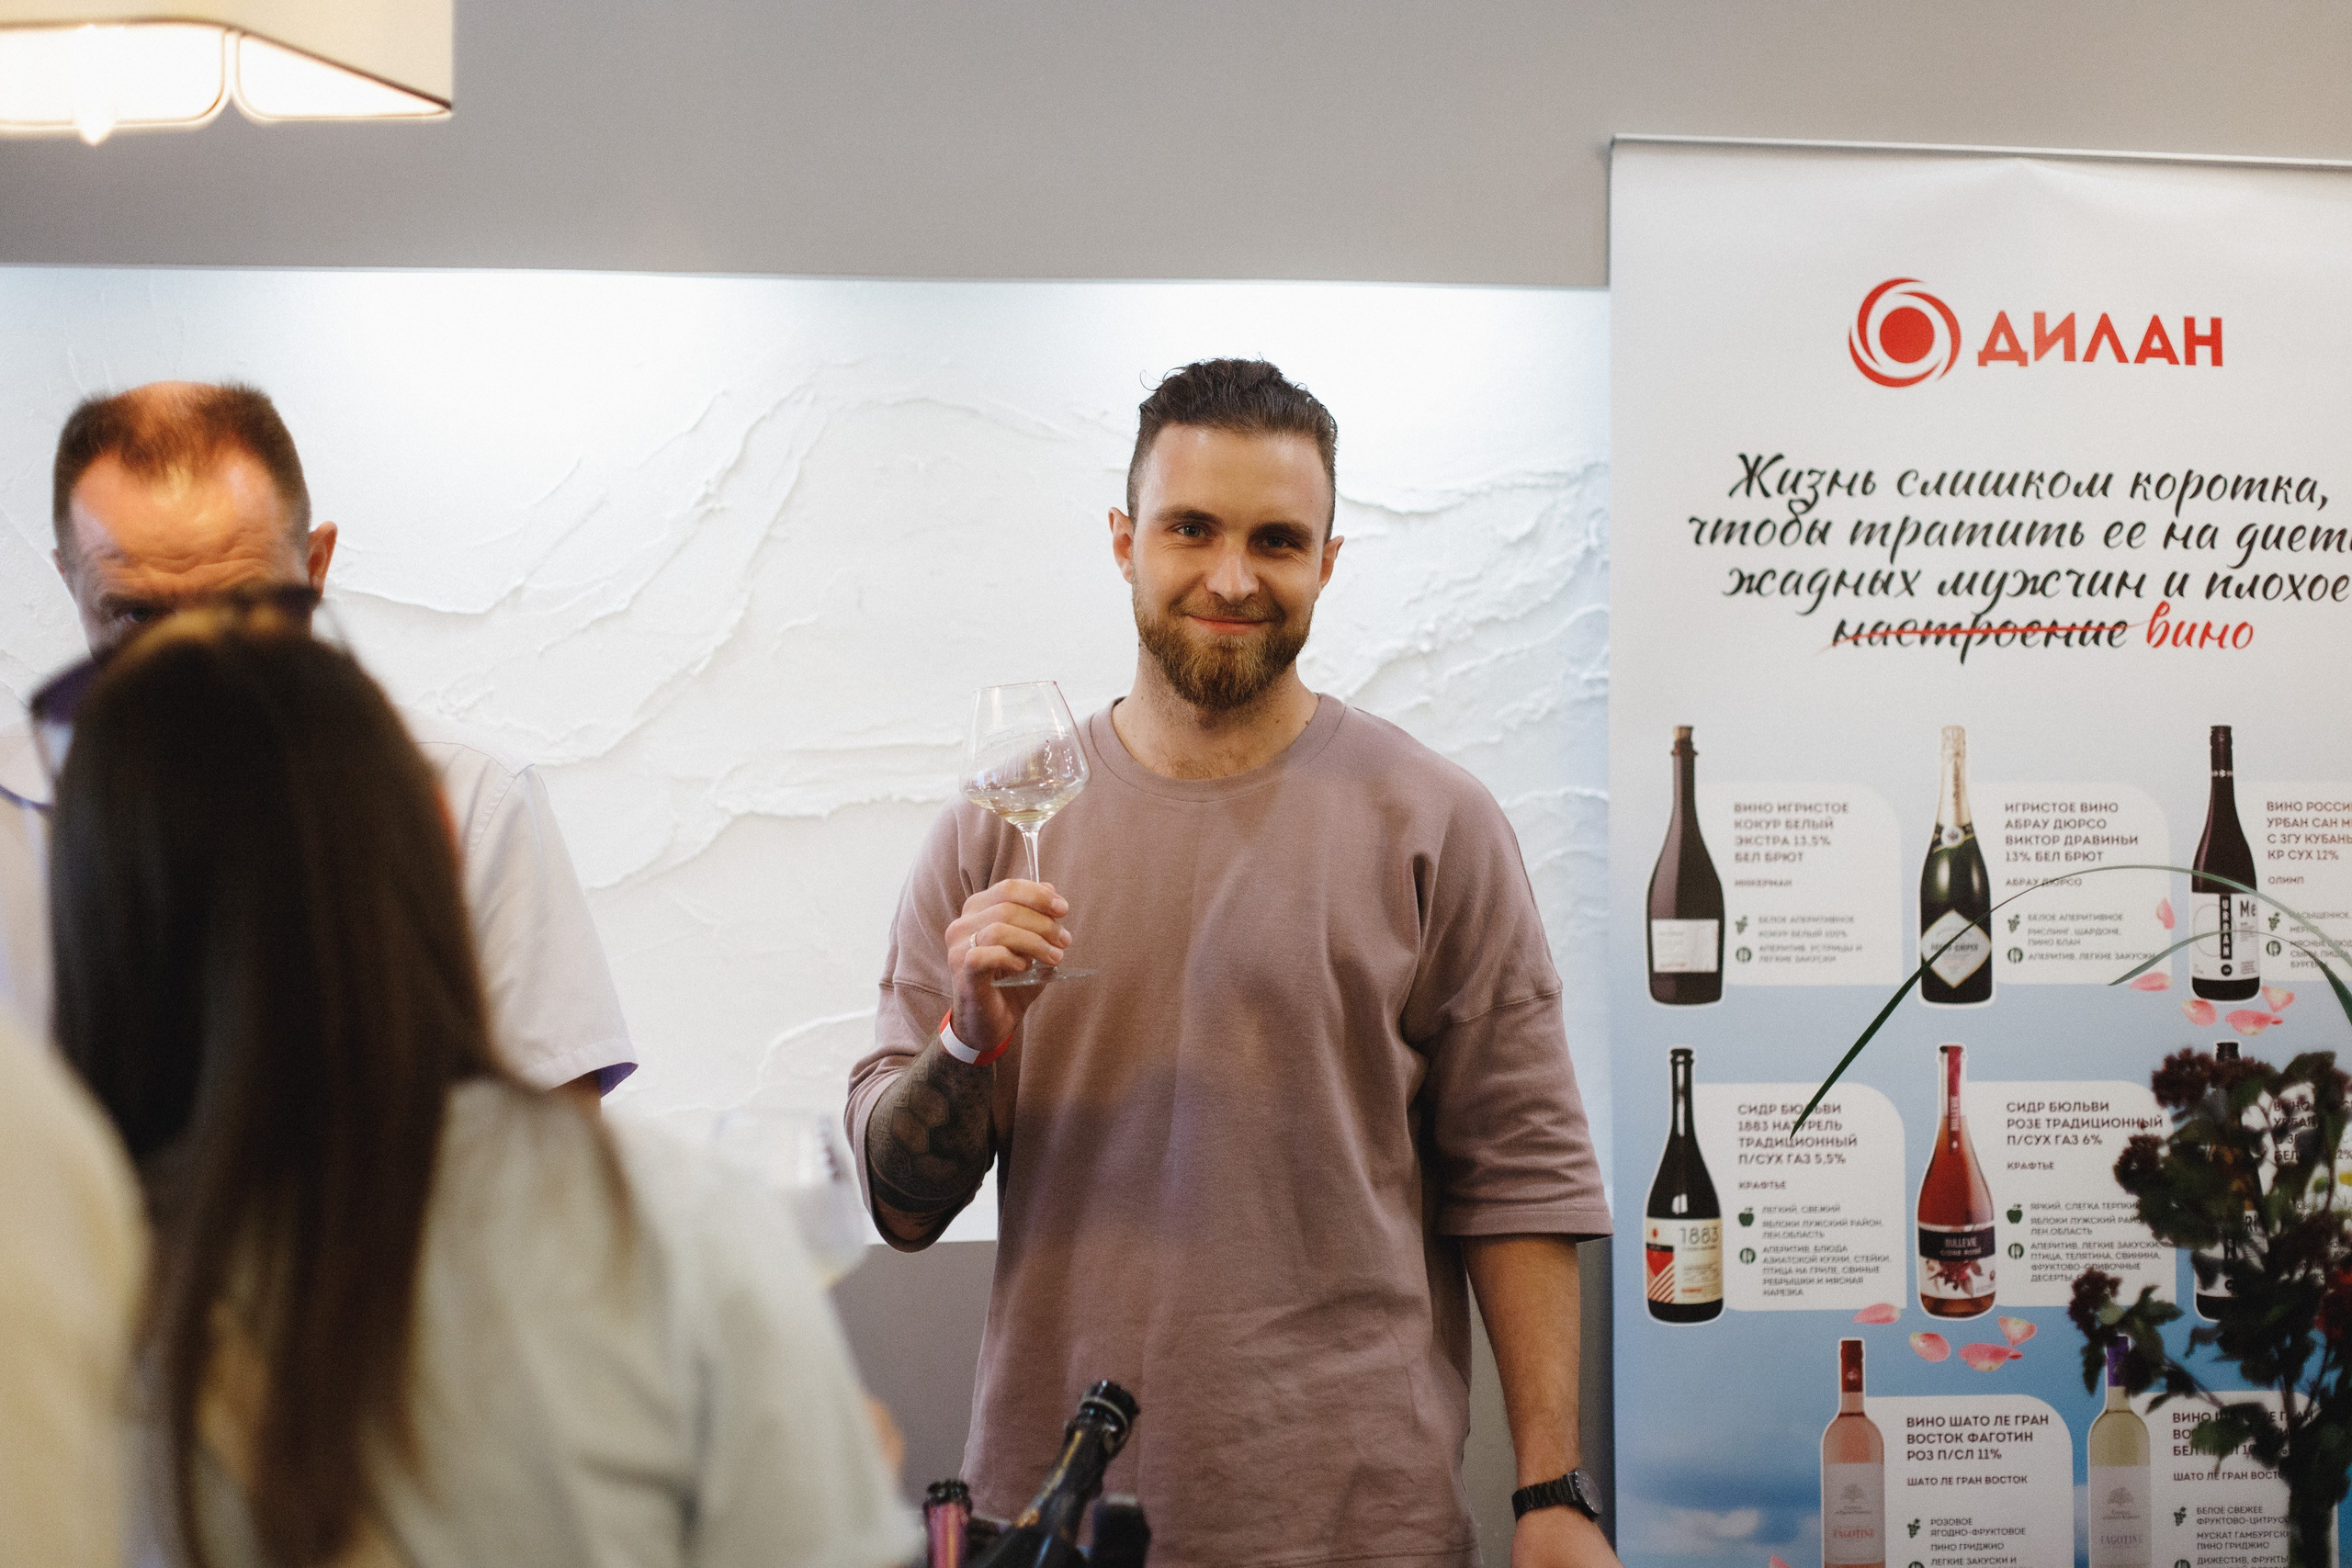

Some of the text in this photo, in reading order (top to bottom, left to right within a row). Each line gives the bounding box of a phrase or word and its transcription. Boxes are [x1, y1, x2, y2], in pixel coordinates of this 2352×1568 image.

[1977, 310, 2223, 367] ДИЛАН
[1728, 453, 2329, 518] Жизнь слишком коротка,
[1688, 498, 1832, 547] чтобы
[1849, 514, 2085, 565] тратить
[2103, 521, 2146, 549] ее
[2163, 522, 2219, 550] на
[1722, 567, 2350, 616] жадных мужчин и плохое
[1831, 600, 2254, 665] настроение вино
[1734, 802, 1849, 814] ВИНО ИГРИСТОЕ
[2005, 802, 2119, 814] ИГРИСТОЕ ВИНО
[2267, 801, 2352, 811] ВИНО РОССИ
[1784, 816, 1834, 829] БЕЛЫЙ
[2005, 818, 2107, 829] АБРАУ ДЮРСО
[2267, 818, 2352, 828] УРБАН САН М
[1735, 835, 1790, 846] ЭКСТРА
[2005, 834, 2139, 846] ВИКТОР ДРАВИНЬИ
[2267, 833, 2277, 843] С
[2280, 833, 2301, 843] ЗГУ
[2006, 851, 2103, 862] 13% БЕЛ БРЮТ
[2267, 850, 2339, 860] КР СУХ 12%
[2006, 878, 2039, 886] АБРАУ
[1738, 1103, 1842, 1115] СИДР БЮЬВИ
[2007, 1101, 2109, 1113] СИДР БЮЛЬВИ
[1739, 1122, 1769, 1131] 1883
[2007, 1115, 2163, 1129] РОЗЕ ТРАДИЦИОННЫЙ
[1739, 1134, 1857, 1148] ТРАДИЦИОННЫЙ
[2007, 1134, 2102, 1145] П/СУХ ГАЗ 6%
[1738, 1154, 1782, 1165] П/СУХ
[1787, 1154, 1811, 1164] ГАЗ
[2007, 1162, 2054, 1170] КРАФТЬЕ
[1679, 1225, 1719, 1245] 1883
[1906, 1415, 2049, 1427] ВИНО ШАТО ЛЕ ГРАН
[2173, 1413, 2211, 1424] ВИНО
[1906, 1432, 2033, 1444] ВОСТОК ФАГОТИН
[1907, 1449, 2002, 1461] РОЗ П/СЛ 11%
[1907, 1475, 2028, 1486] ШАТО ЛЕ ГРАН ВОСТОК
[2173, 1472, 2204, 1481] ШАТО
[2206, 1472, 2220, 1481] ЛЕ
[2222, 1472, 2248, 1480] ГРАН
[2197, 1506, 2263, 1515] БЕЛОЕ СВЕЖЕЕ
[1931, 1518, 1973, 1527] РОЗОВОЕ
[2197, 1531, 2232, 1540] МУСКАТ
[2197, 1541, 2269, 1551] ПИНО ГРИДЖИО
[1966, 1557, 2008, 1565] ЗАКУСКИ
